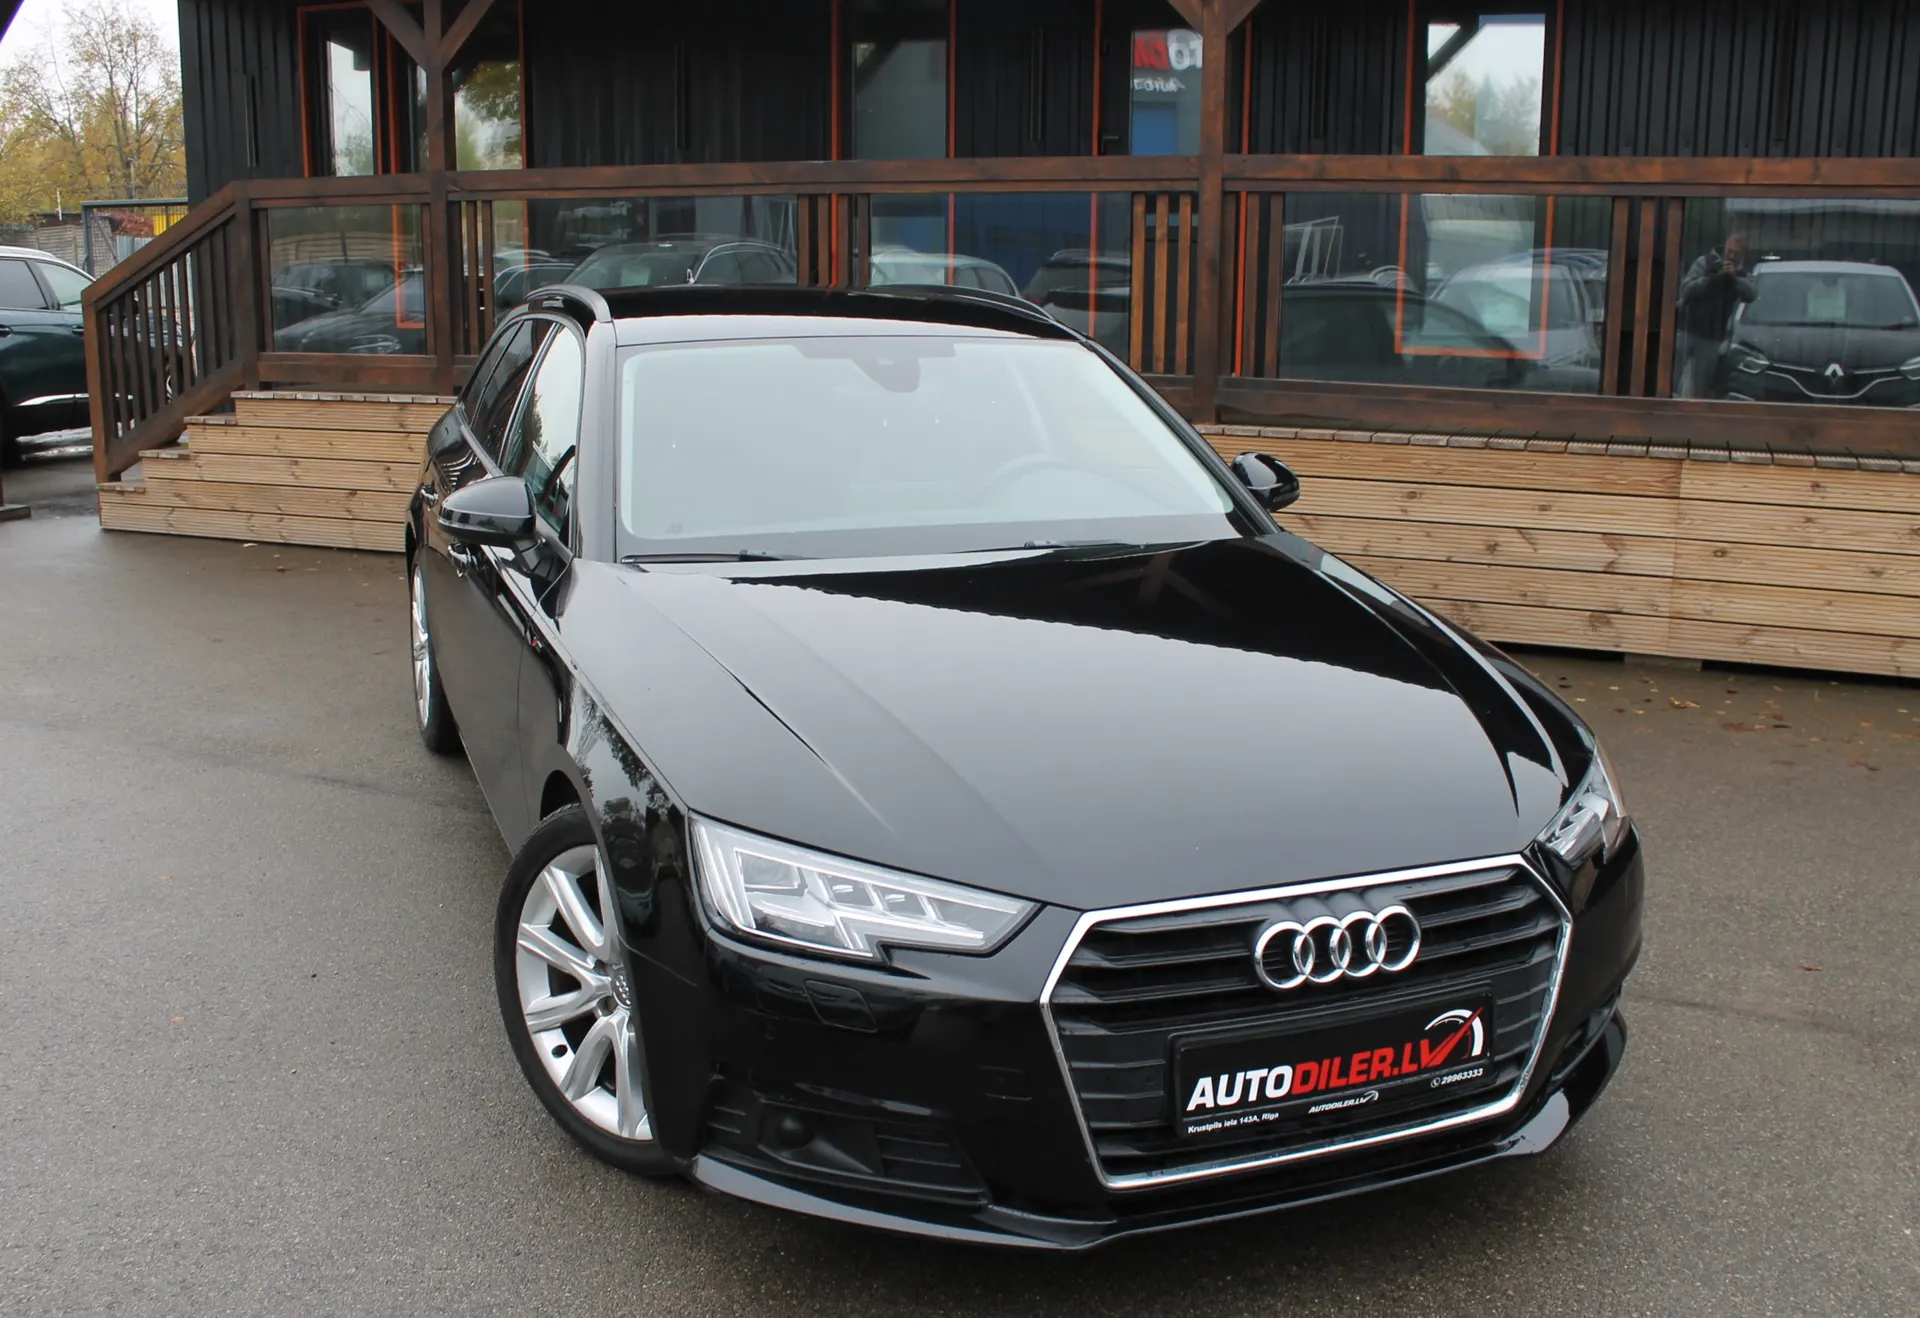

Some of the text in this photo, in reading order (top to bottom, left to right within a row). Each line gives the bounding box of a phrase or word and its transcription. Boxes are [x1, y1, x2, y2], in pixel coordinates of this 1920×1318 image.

[1187, 1007, 1484, 1112] AUTODILER.LV
[1441, 1068, 1484, 1085] 29963333
[1188, 1121, 1222, 1134] Krustpils
[1224, 1119, 1238, 1127] iela
